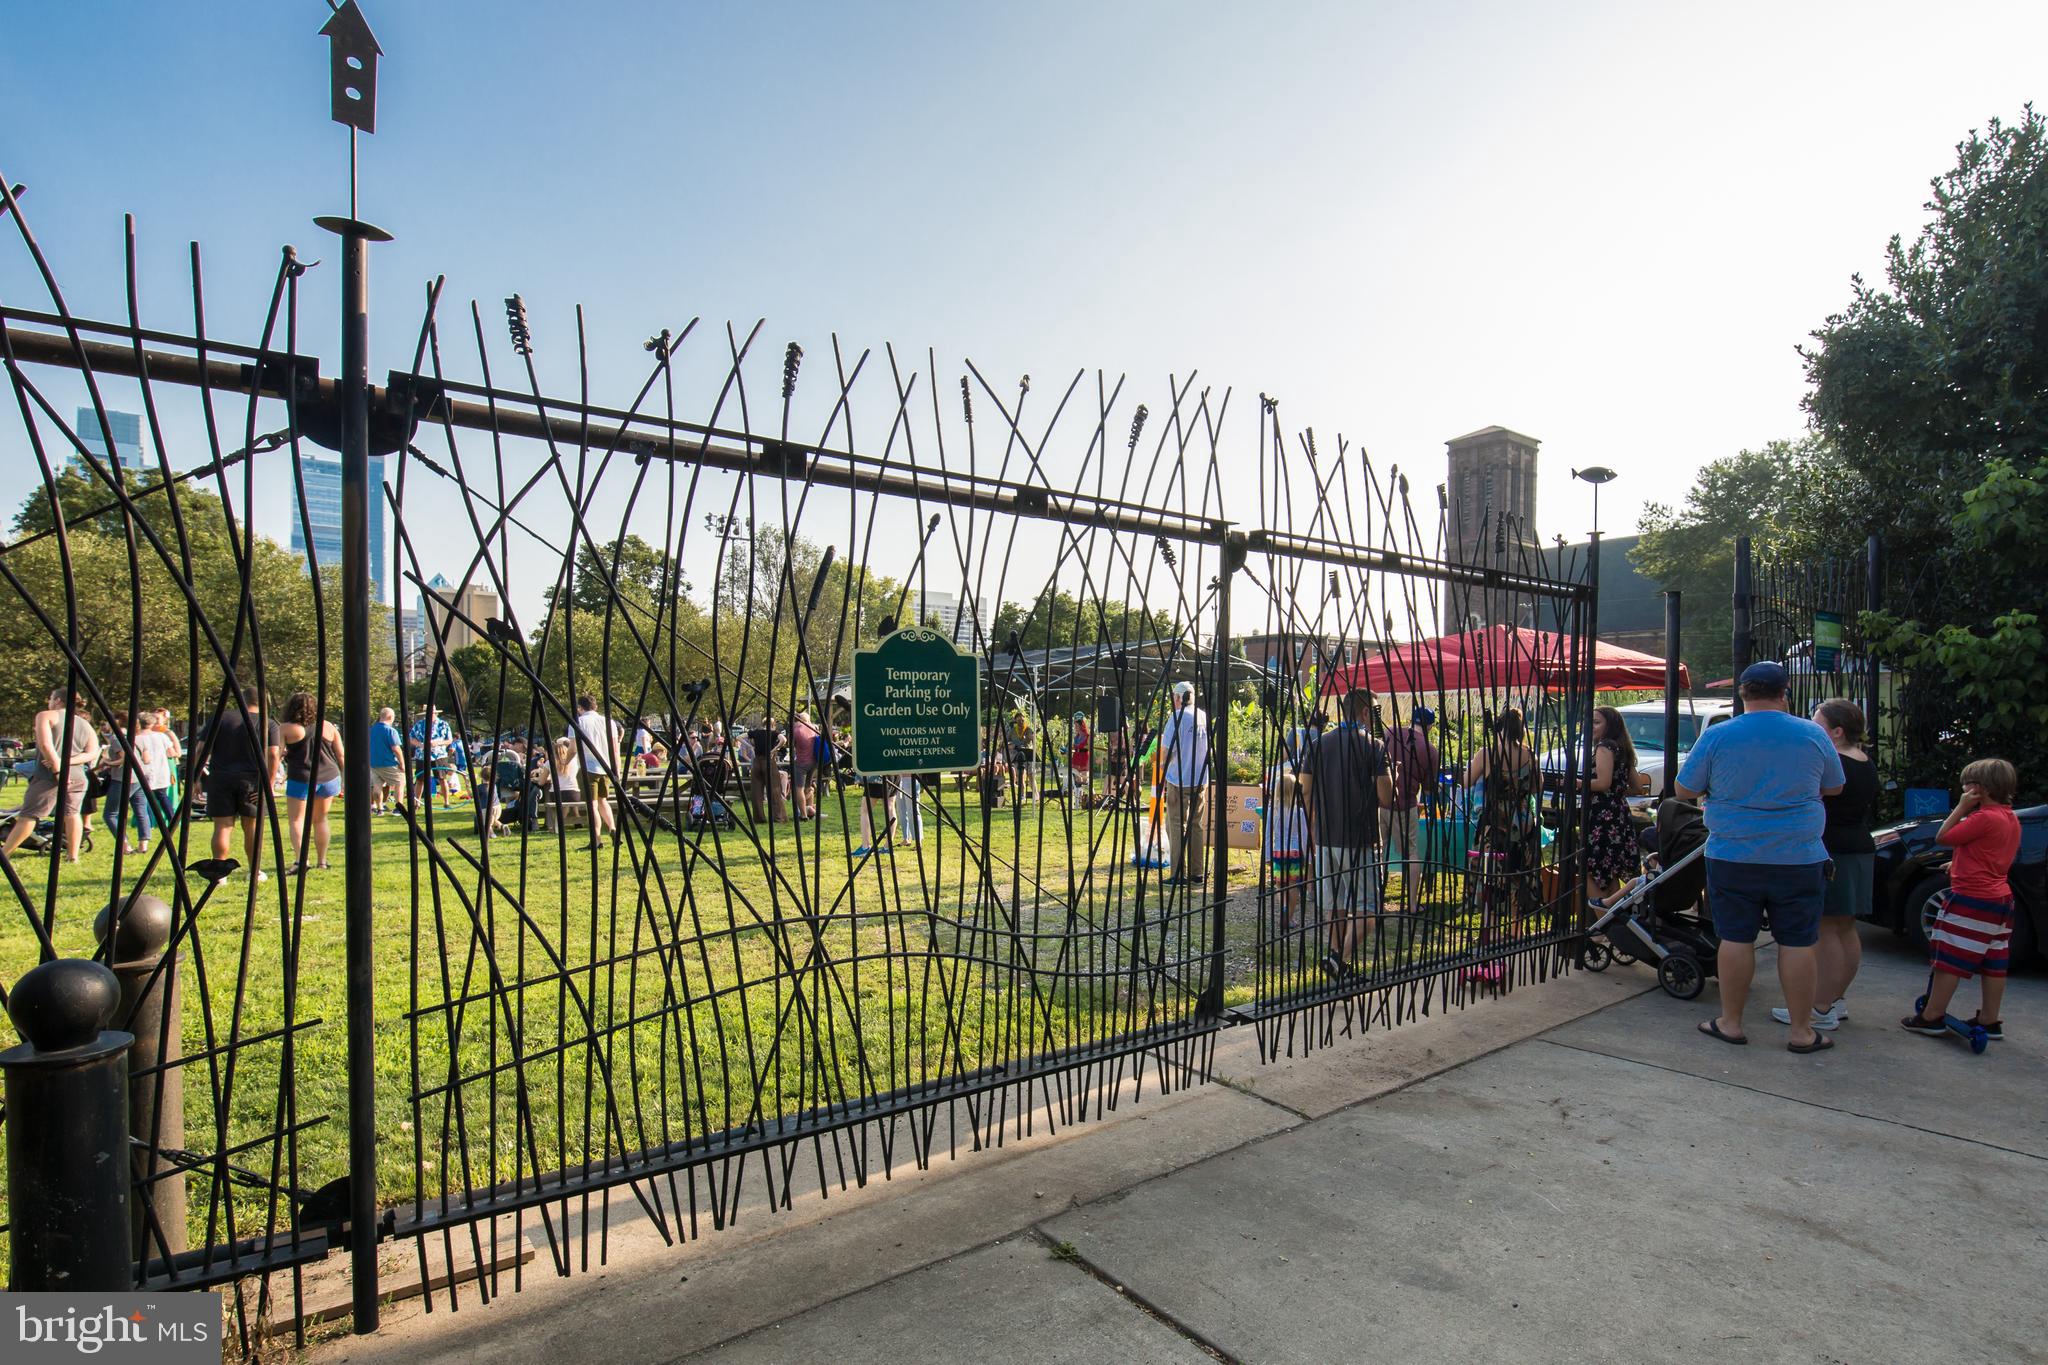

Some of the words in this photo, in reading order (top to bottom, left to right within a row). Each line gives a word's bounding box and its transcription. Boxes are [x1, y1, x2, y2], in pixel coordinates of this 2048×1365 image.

[885, 667, 950, 684] Temporary
[885, 685, 931, 701] Parking
[935, 685, 952, 698] for
[864, 703, 911, 717] Garden
[916, 704, 938, 716] Use
[942, 702, 970, 719] Only
[880, 727, 927, 736] VIOLATORS
[929, 727, 946, 735] MAY
[948, 726, 957, 734] BE
[899, 737, 929, 746] TOWED
[930, 737, 940, 745] AT
[883, 748, 921, 757] OWNER'S
[923, 747, 956, 756] EXPENSE
